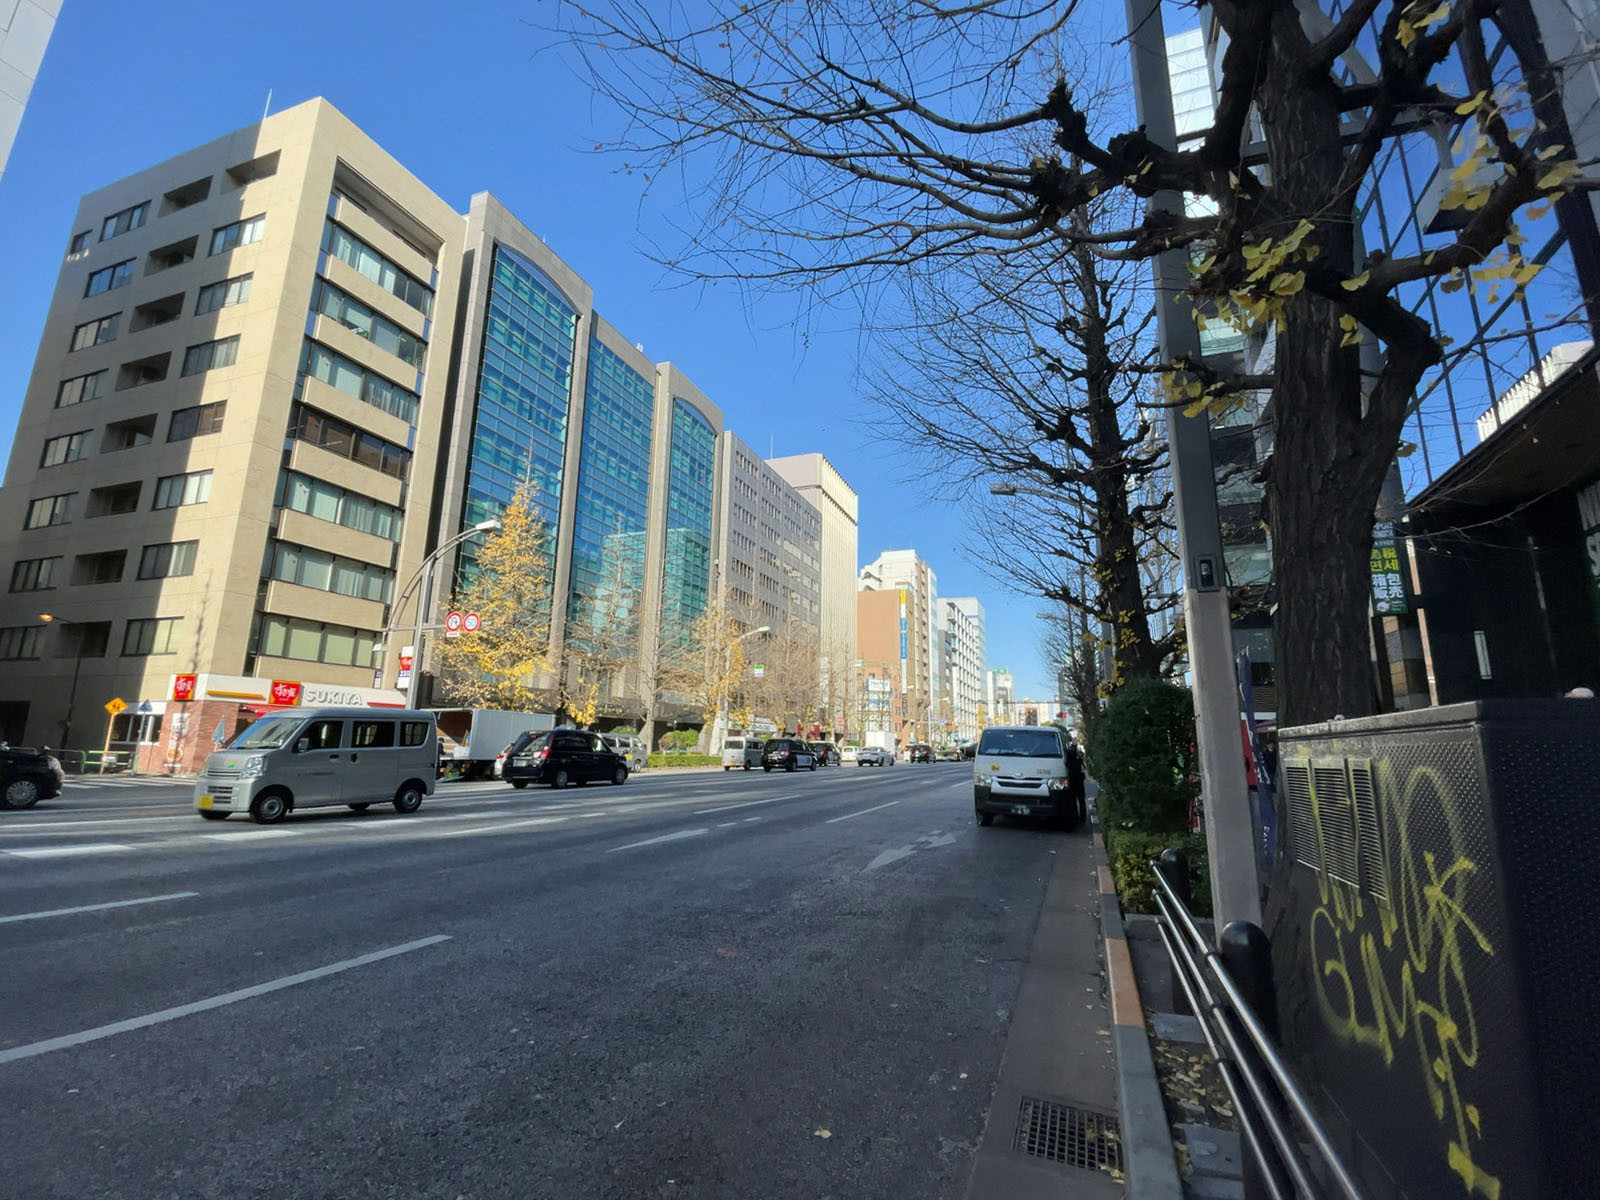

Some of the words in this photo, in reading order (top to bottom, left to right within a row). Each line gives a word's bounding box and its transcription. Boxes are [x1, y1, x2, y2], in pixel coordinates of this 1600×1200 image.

[1370, 560, 1399, 572] 면세
[1374, 586, 1404, 599] 販売
[306, 689, 363, 705] SUKIYA
